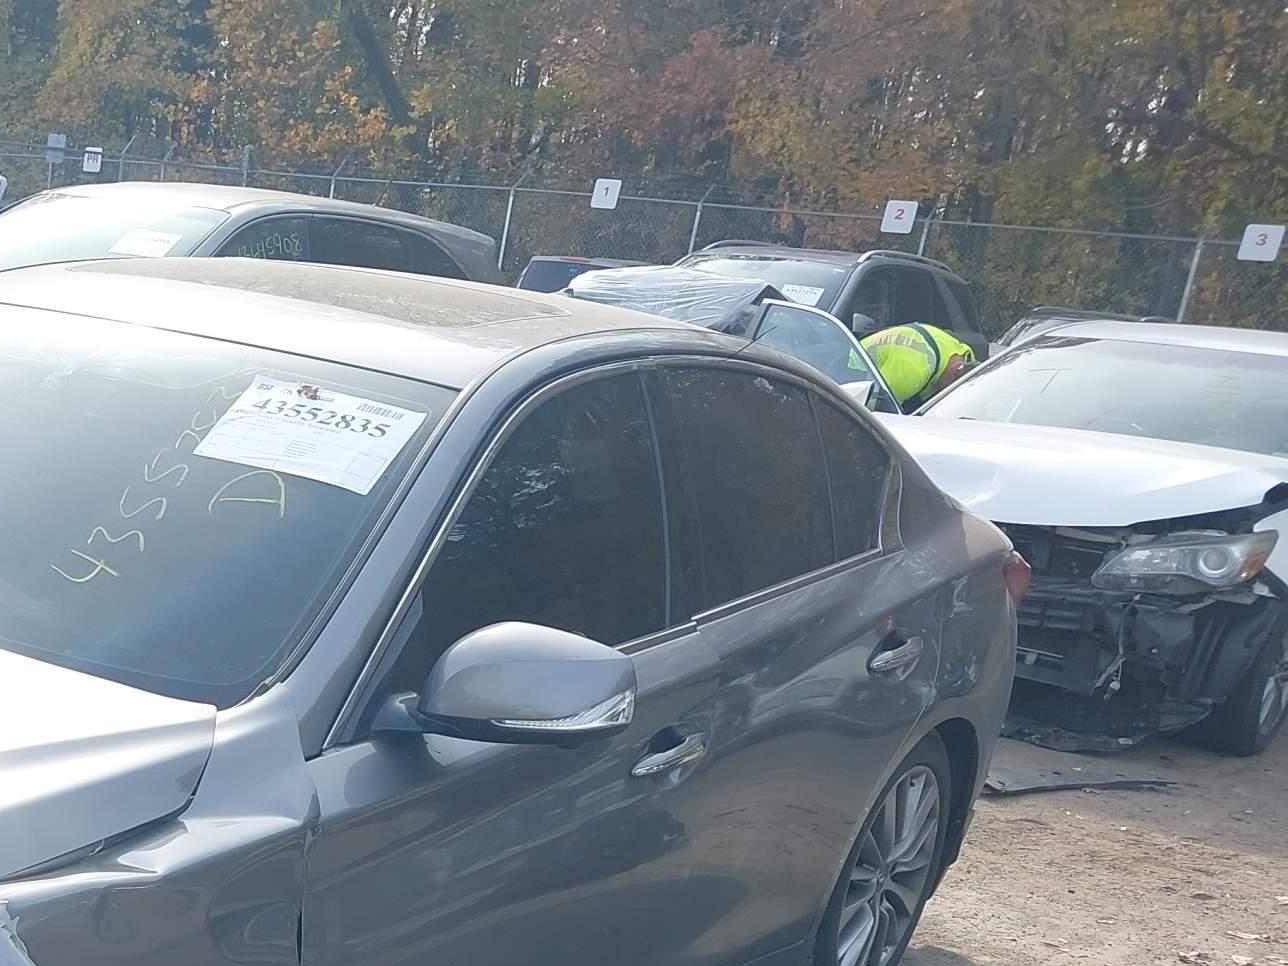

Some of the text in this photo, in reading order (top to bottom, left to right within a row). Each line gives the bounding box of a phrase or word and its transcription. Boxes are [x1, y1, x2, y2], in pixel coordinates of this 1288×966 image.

[603, 185, 611, 198] 1
[894, 208, 905, 220] 2
[1255, 233, 1268, 246] 3
[251, 397, 393, 439] 43552835
